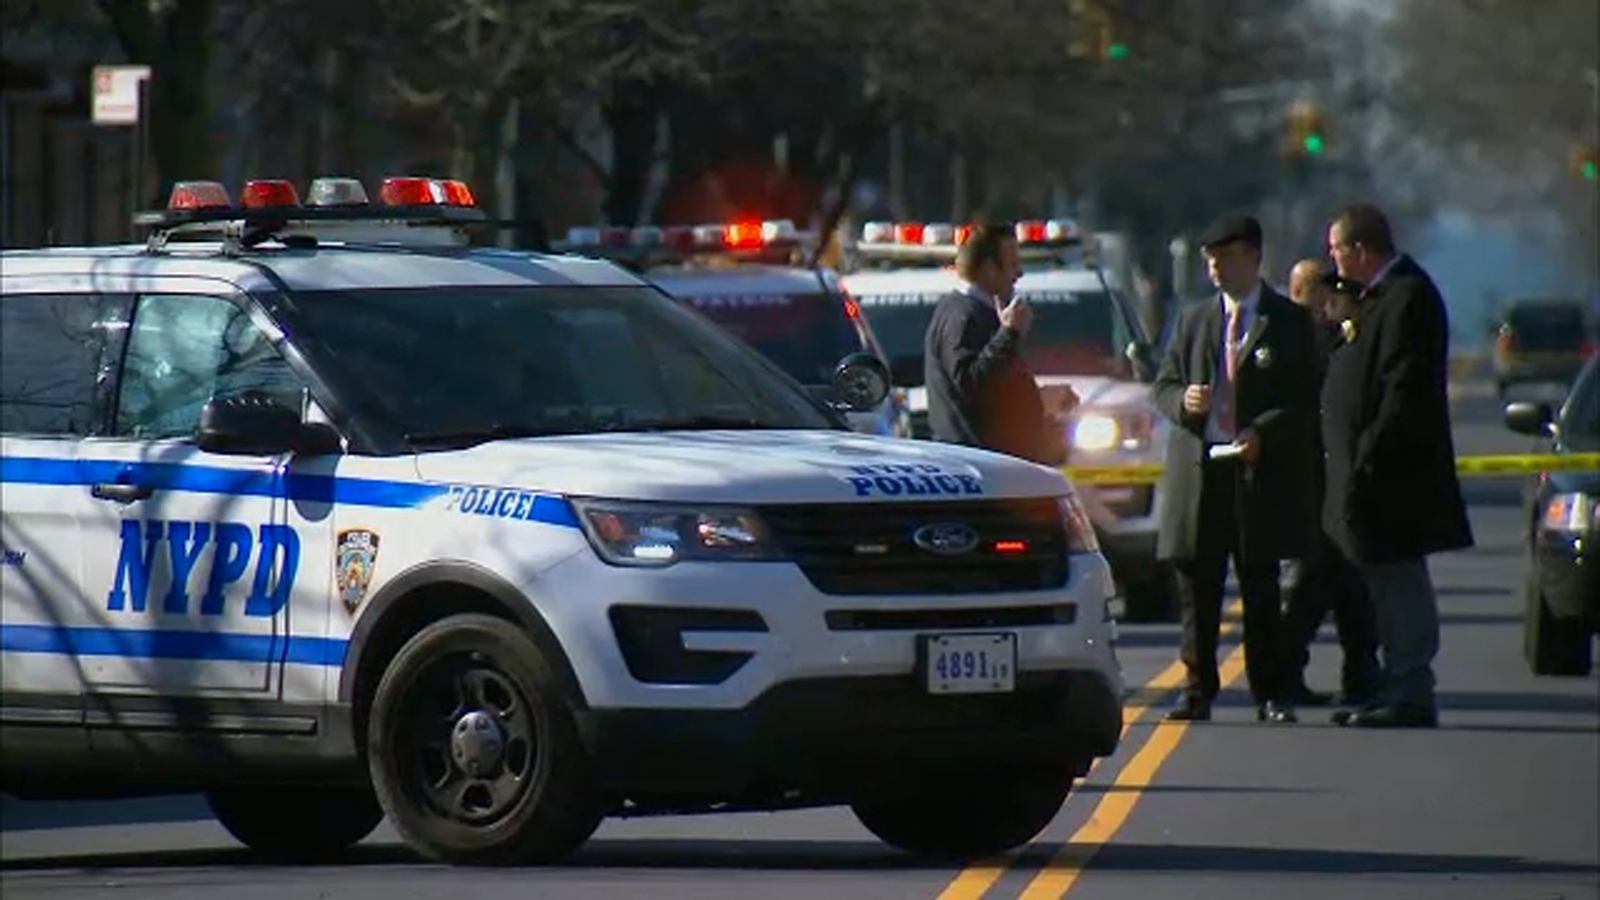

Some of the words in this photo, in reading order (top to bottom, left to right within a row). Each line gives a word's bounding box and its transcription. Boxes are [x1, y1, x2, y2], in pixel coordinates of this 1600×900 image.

[847, 475, 983, 496] POLICE
[446, 486, 531, 520] POLICE
[107, 519, 301, 616] NYPD
[936, 650, 988, 679] 4891
